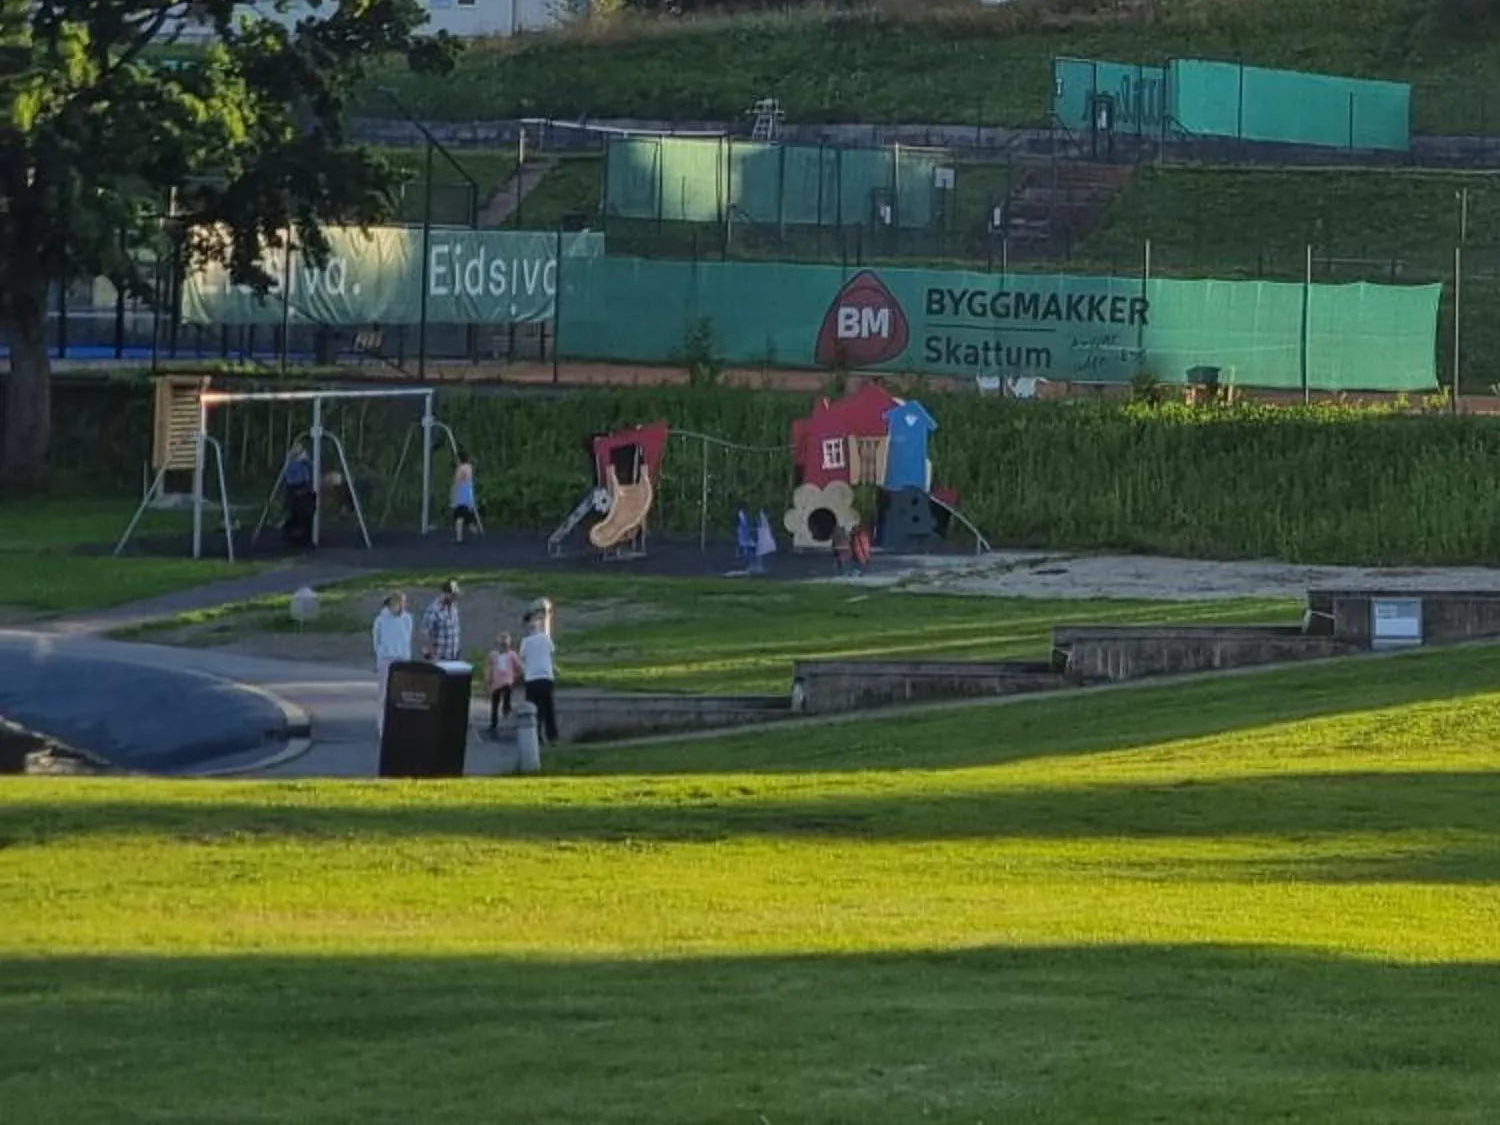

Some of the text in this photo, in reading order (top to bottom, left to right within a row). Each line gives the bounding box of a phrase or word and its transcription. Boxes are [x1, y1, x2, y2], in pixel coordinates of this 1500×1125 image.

[837, 305, 890, 340] BM
[925, 287, 1150, 326] BYGGMAKKER
[924, 335, 1052, 369] Skattum
